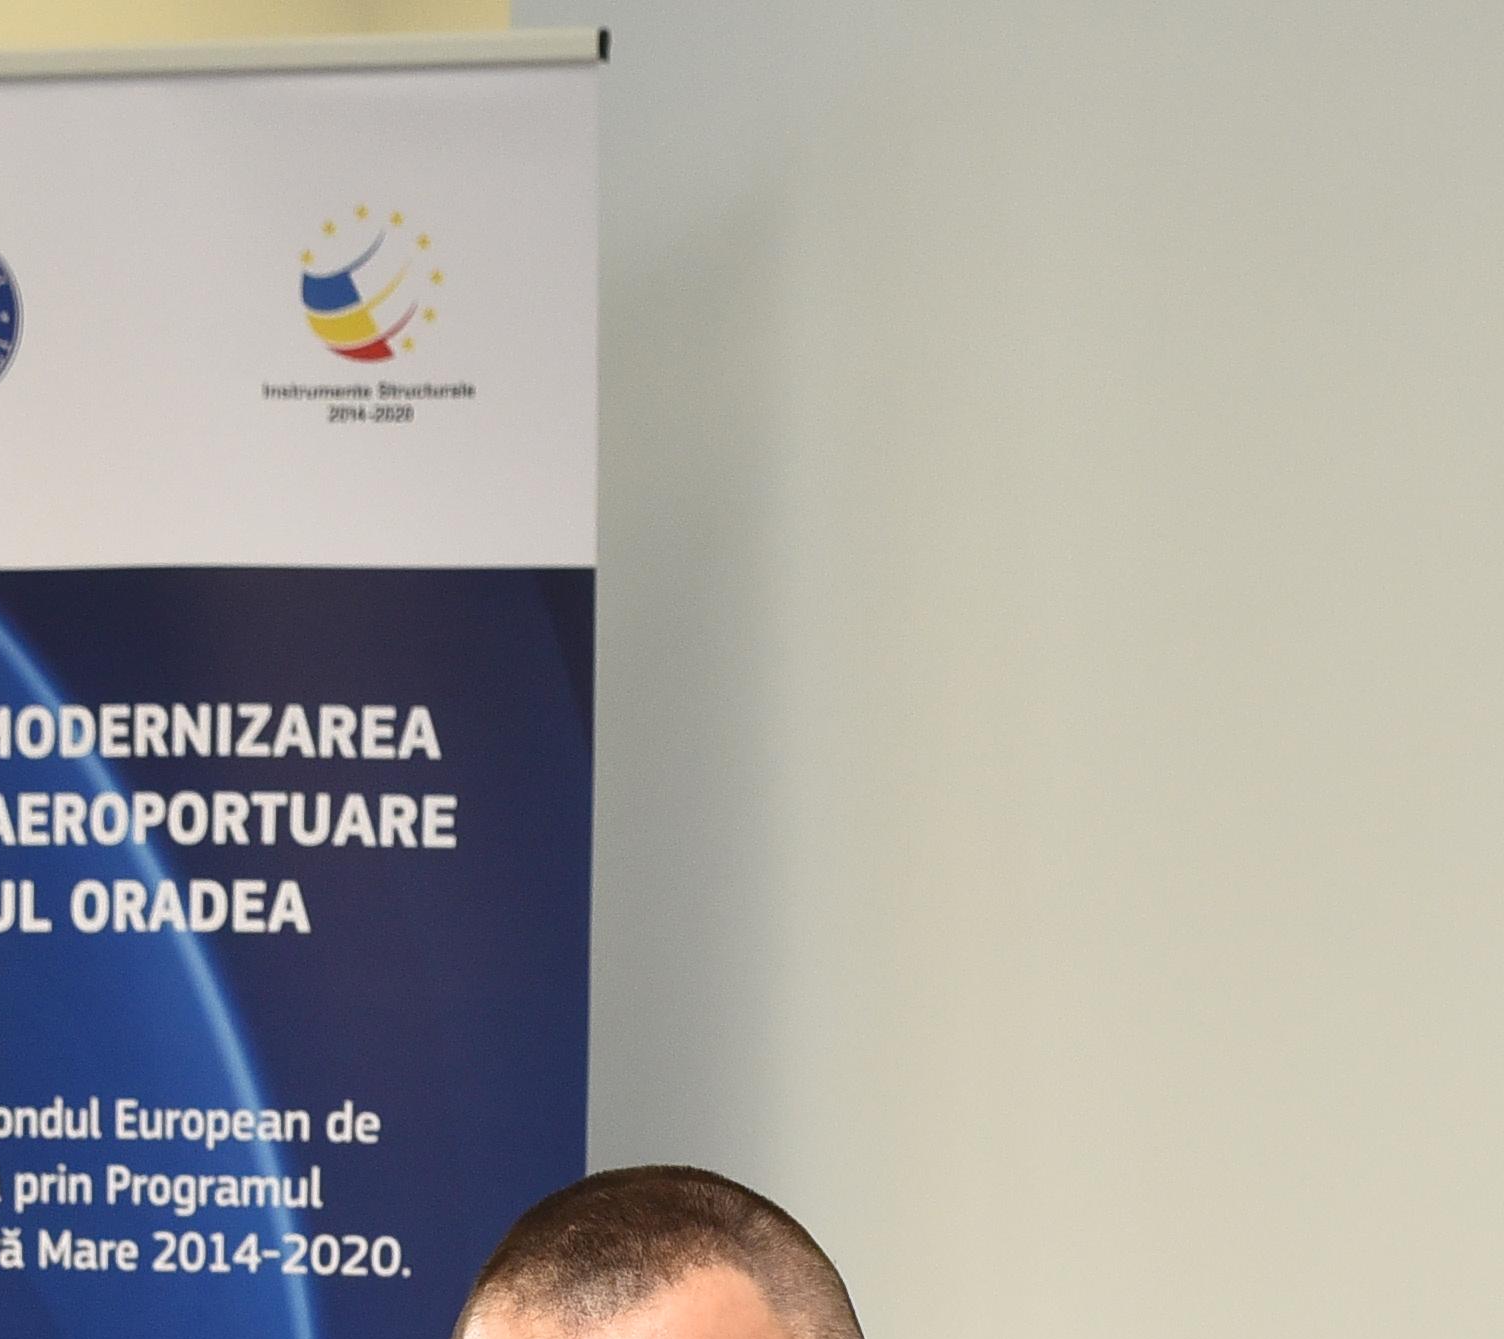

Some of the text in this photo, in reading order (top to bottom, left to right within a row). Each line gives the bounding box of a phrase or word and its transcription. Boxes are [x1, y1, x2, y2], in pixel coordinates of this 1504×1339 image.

[70, 878, 311, 934] ORADEA
[115, 1098, 311, 1151] European
[326, 1099, 381, 1144] de
[14, 1163, 93, 1214] prin
[106, 1164, 324, 1217] Programul
[38, 1229, 139, 1272] Mare
[152, 1230, 411, 1278] 2014-2020.
